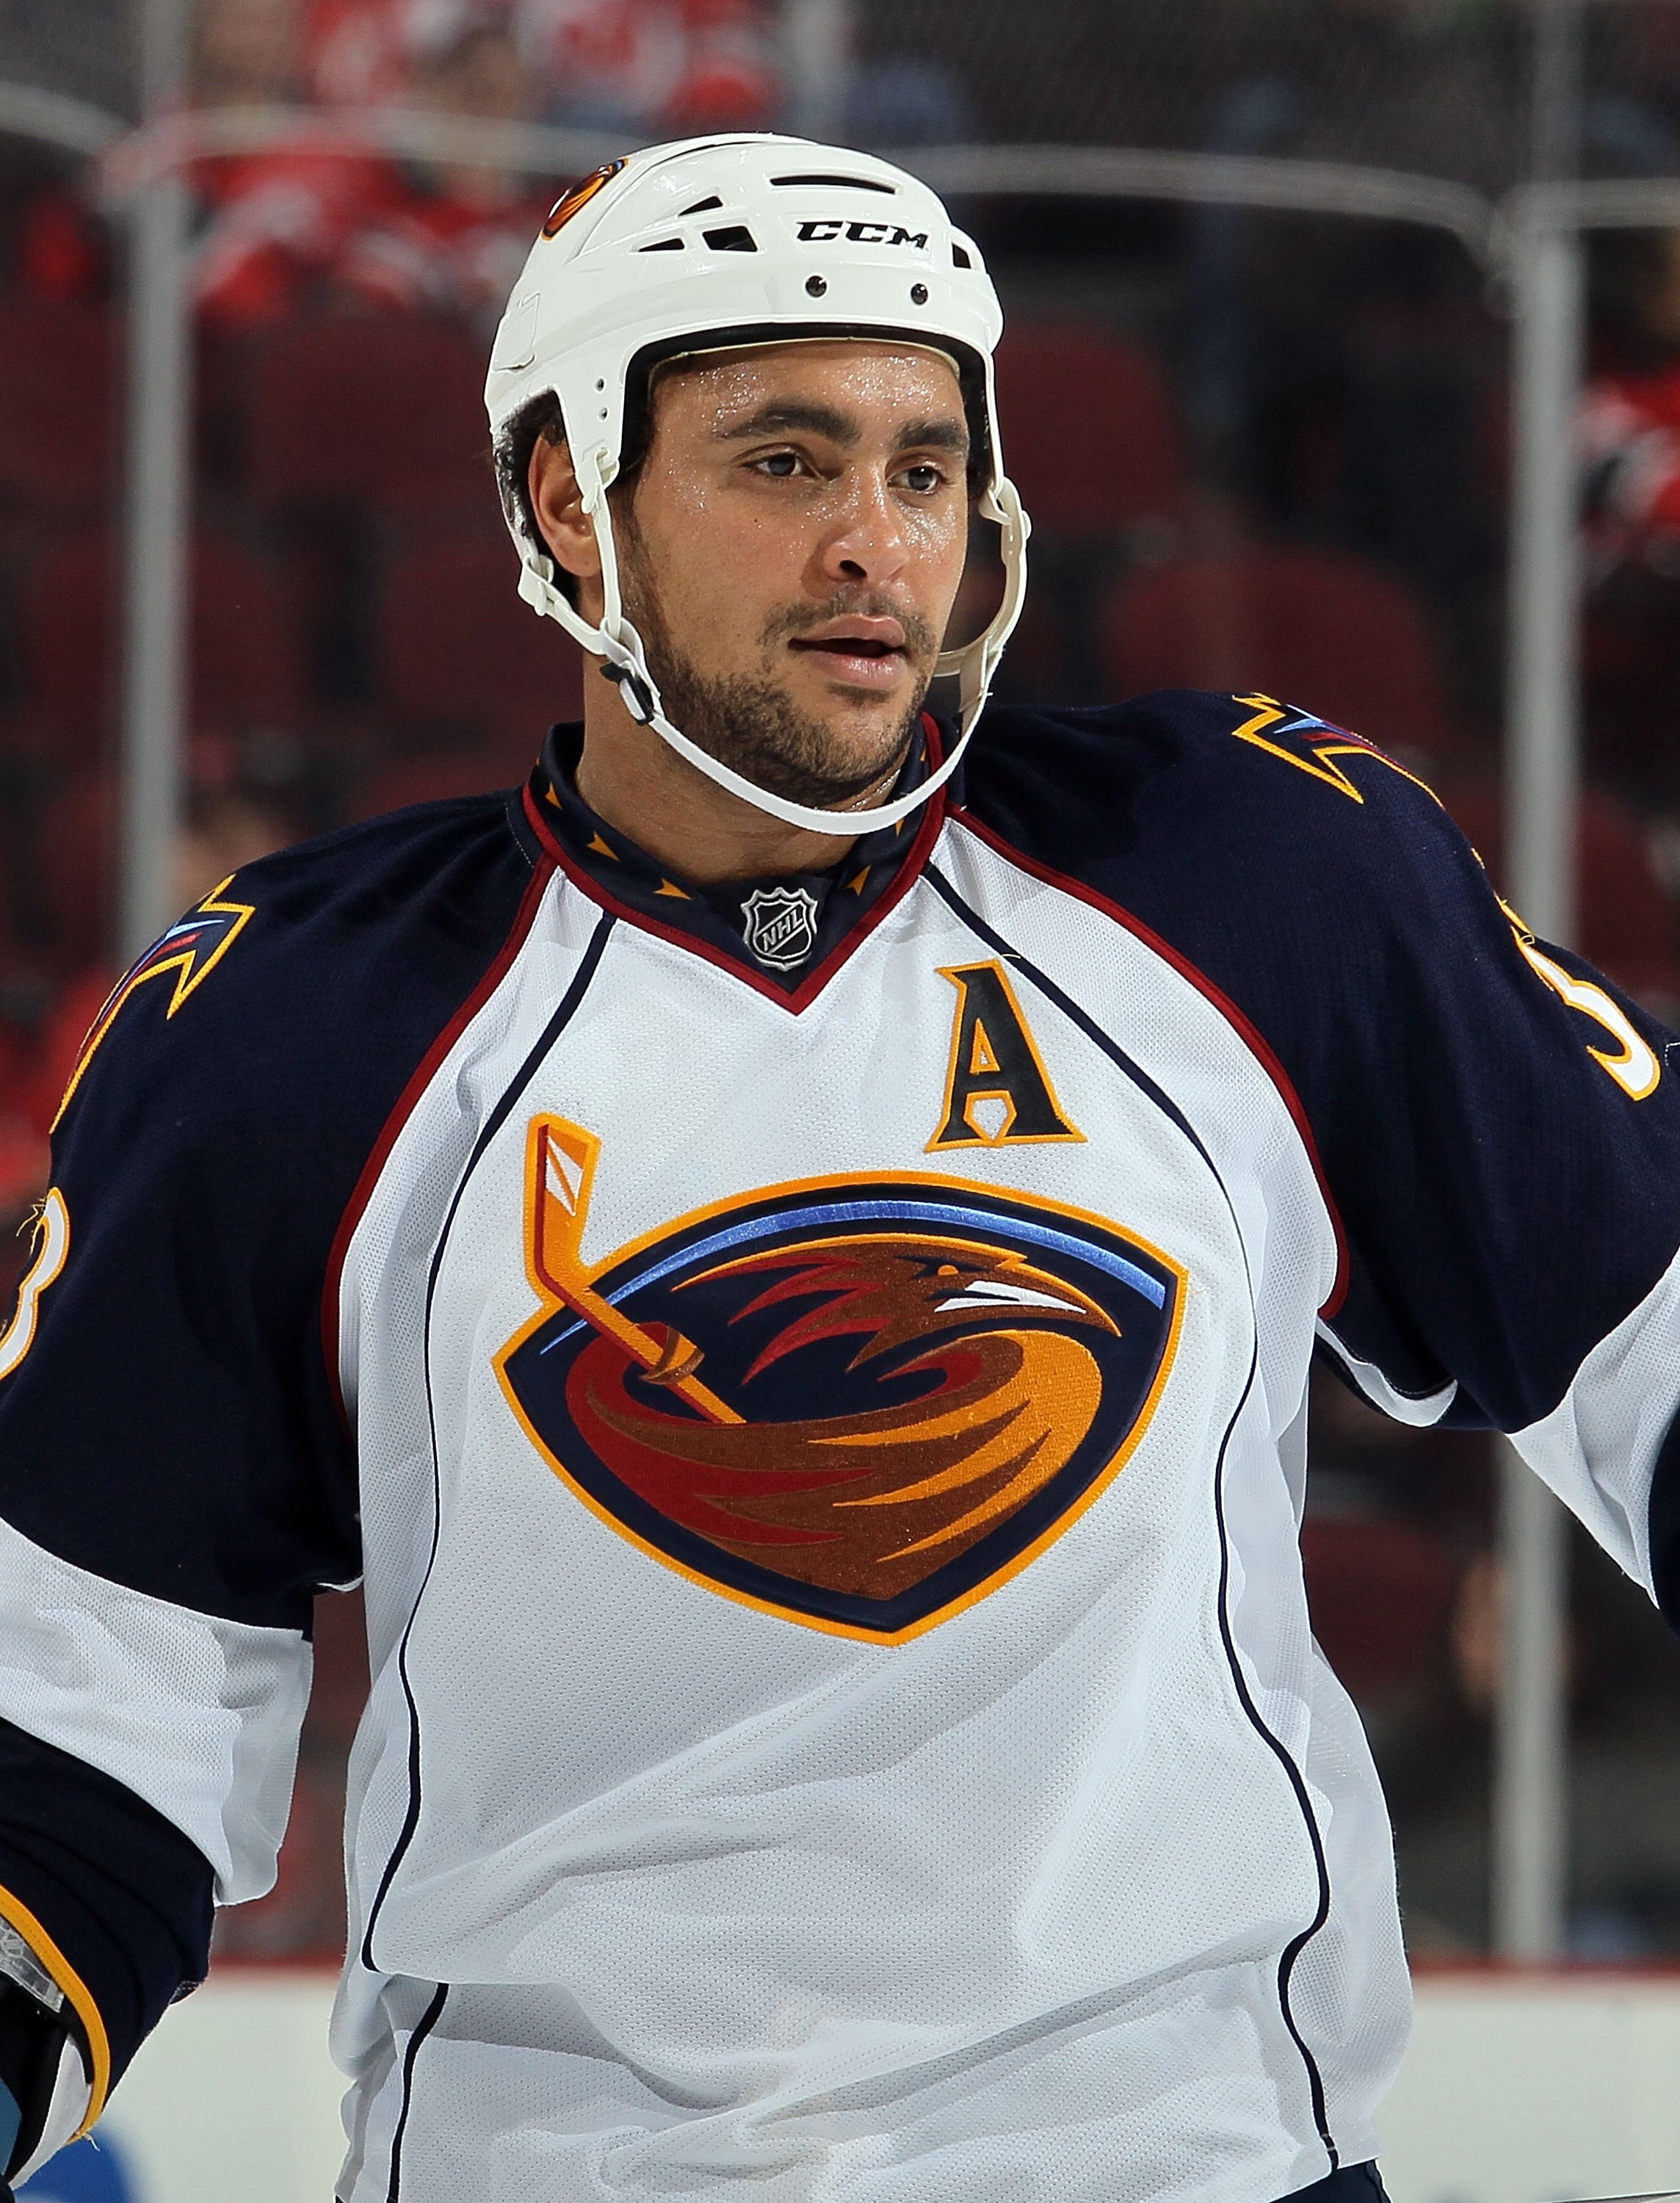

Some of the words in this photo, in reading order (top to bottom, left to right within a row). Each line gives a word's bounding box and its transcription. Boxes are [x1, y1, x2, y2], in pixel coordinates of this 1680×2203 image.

[796, 220, 929, 250] CCM
[761, 909, 803, 952] NHL
[924, 958, 1089, 1154] A
